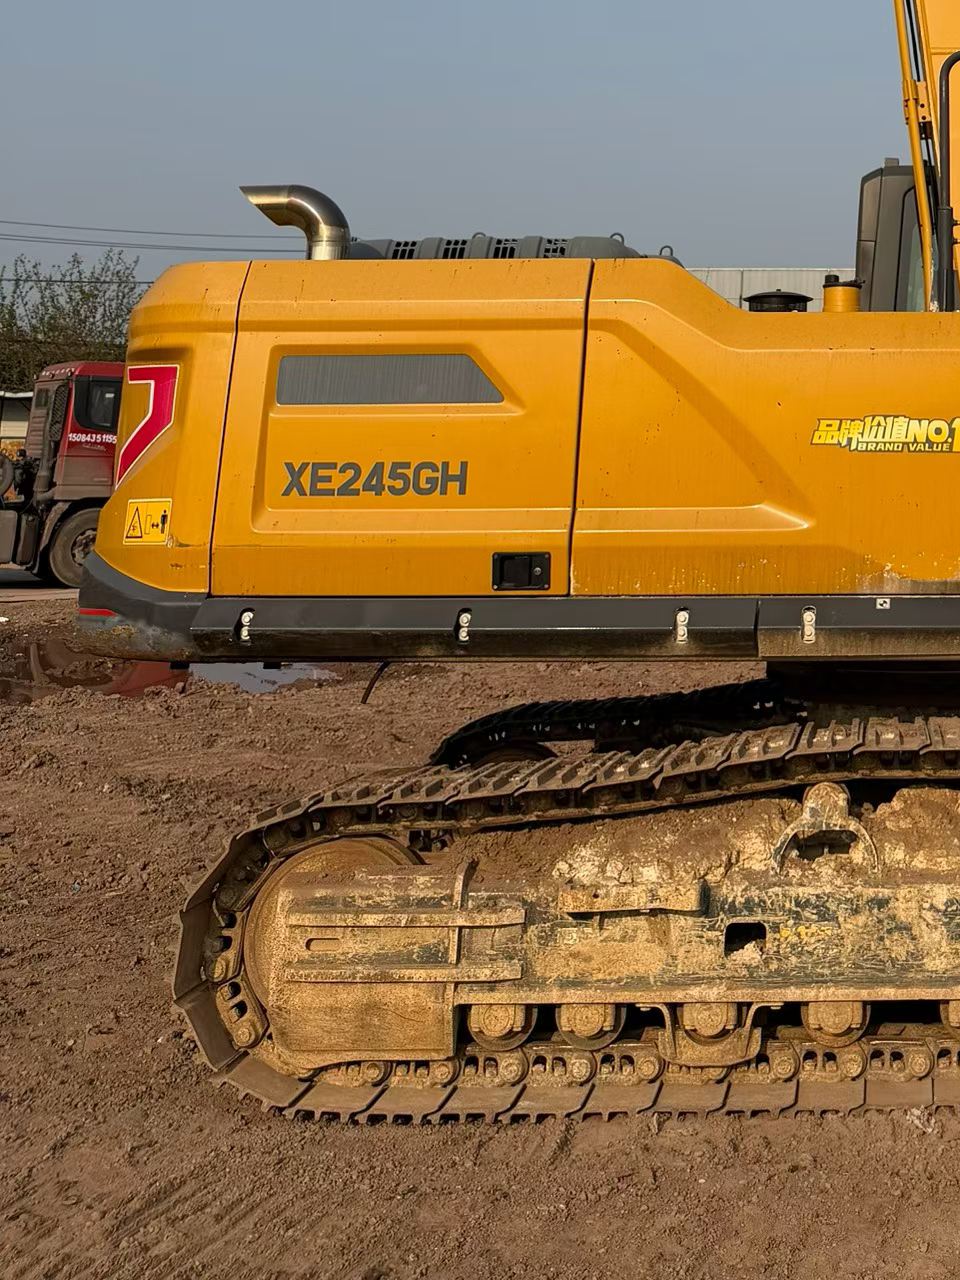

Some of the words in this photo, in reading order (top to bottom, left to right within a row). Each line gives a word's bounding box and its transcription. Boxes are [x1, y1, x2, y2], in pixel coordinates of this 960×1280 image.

[857, 442, 903, 452] BRAND
[908, 442, 951, 452] VALUE
[281, 461, 469, 497] XE245GH
